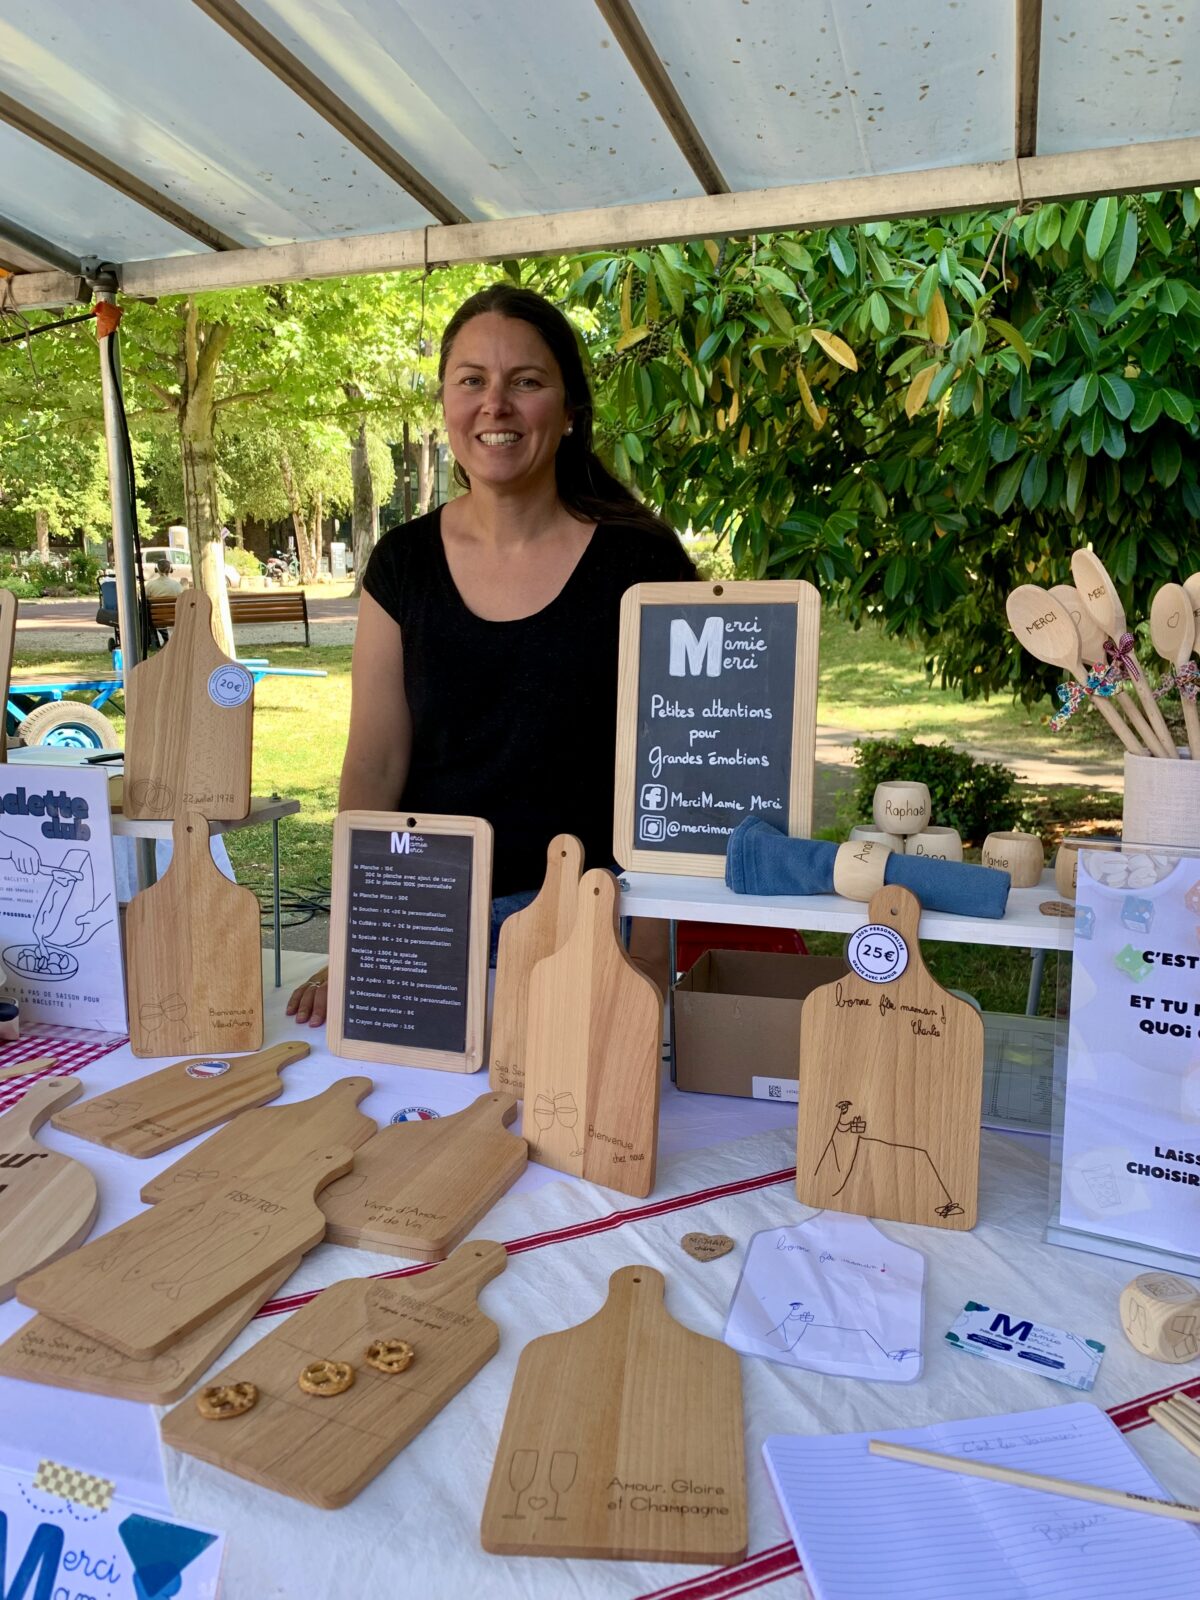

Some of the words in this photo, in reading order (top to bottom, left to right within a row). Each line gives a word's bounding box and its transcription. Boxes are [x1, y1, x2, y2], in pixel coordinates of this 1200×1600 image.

[1026, 611, 1057, 634] MERCI
[220, 679, 241, 692] 20€
[651, 694, 694, 718] Petites
[702, 699, 772, 719] attentions
[690, 729, 720, 746] pour
[709, 749, 770, 767] émotions
[0, 787, 88, 819] clette
[750, 792, 782, 811] Merci
[984, 851, 1008, 868] Mamie
[862, 944, 895, 962] 25€
[33, 998, 64, 1007] RACLETTE
[1130, 995, 1155, 1009] ET
[1161, 999, 1188, 1014] TU
[588, 1124, 633, 1150] Bienvenue
[612, 1153, 626, 1163] chez
[630, 1153, 644, 1161] nous
[671, 1479, 724, 1495] Gloire
[608, 1496, 622, 1510] et
[630, 1497, 729, 1518] Champagne
